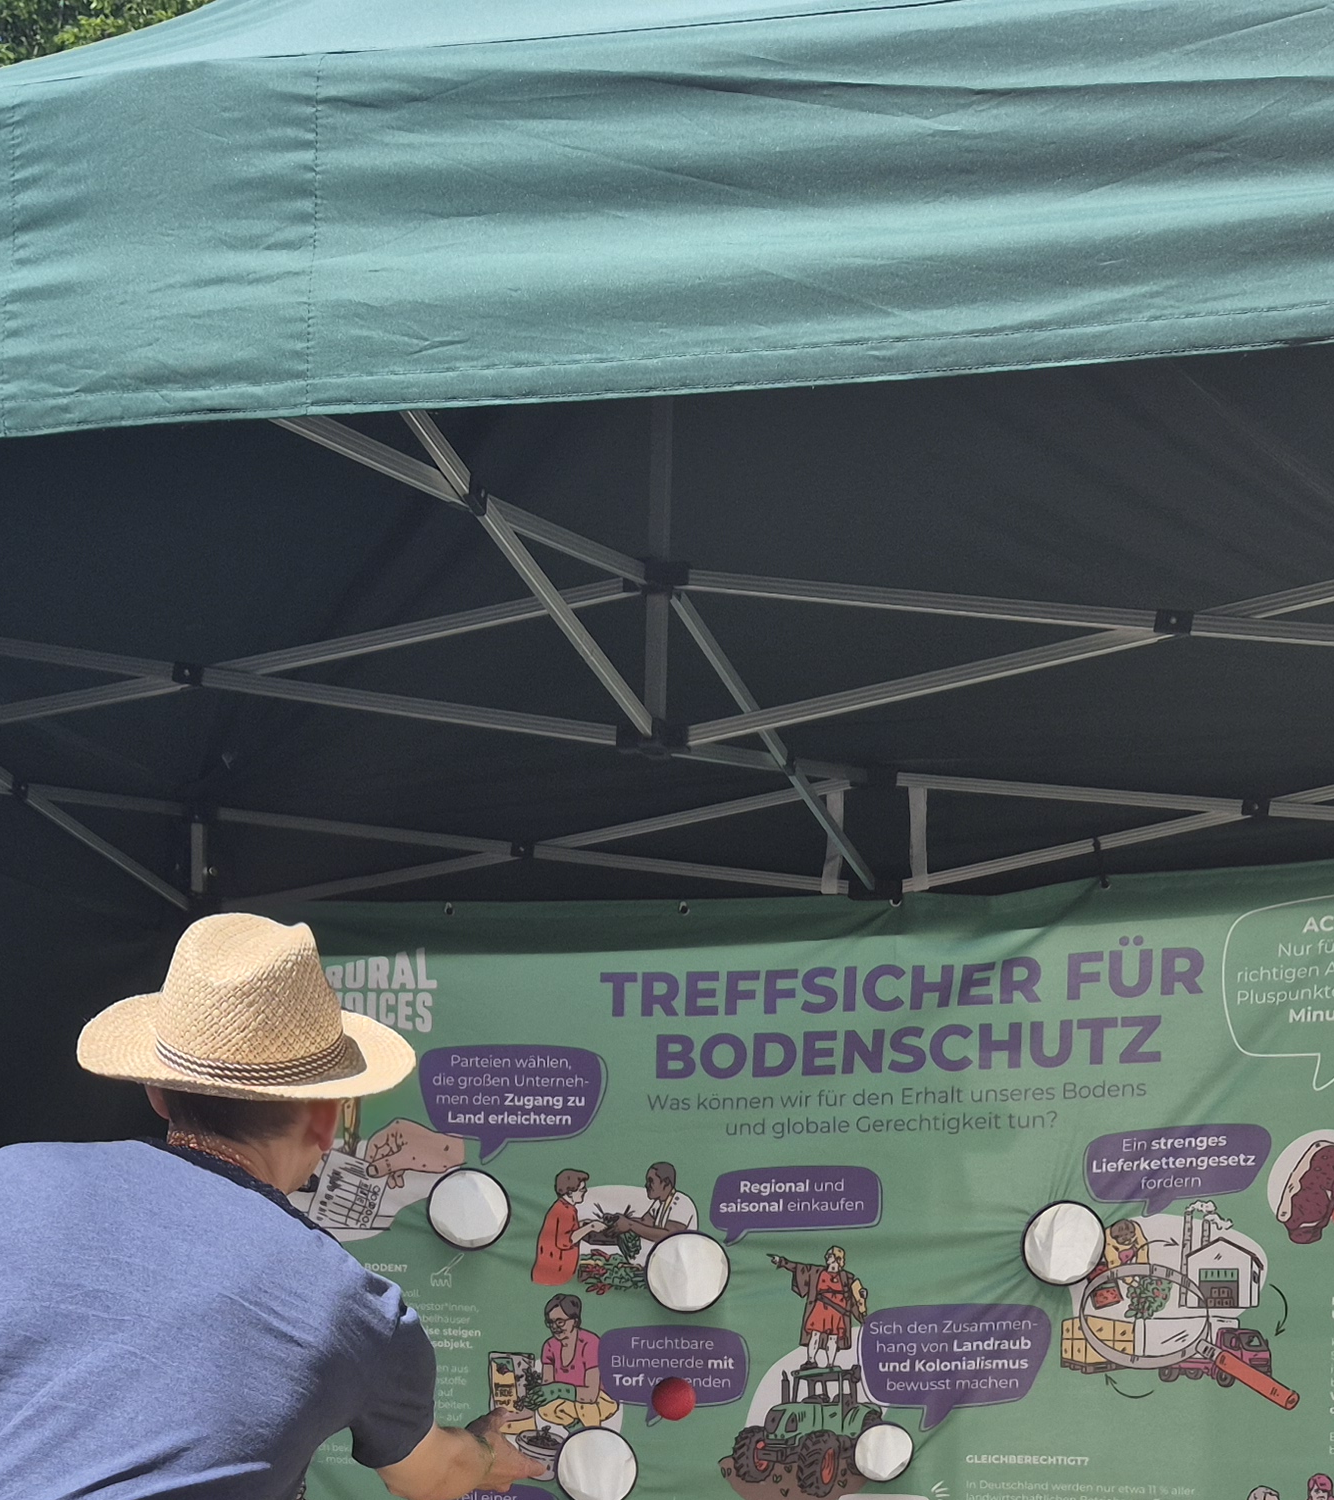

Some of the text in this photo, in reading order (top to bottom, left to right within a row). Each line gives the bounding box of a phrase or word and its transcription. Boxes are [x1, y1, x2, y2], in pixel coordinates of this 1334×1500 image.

[1277, 942, 1313, 957] Nur
[325, 947, 438, 989] RURAL
[1065, 935, 1205, 1000] FÜR
[1236, 965, 1319, 983] richtigen
[599, 955, 1042, 1016] TREFFSICHER
[336, 991, 433, 1033] OICES
[655, 1015, 1162, 1078] BODENSCHUTZ
[450, 1054, 572, 1070] Parteien wählen,
[431, 1072, 589, 1089] die großen Unterneh-
[435, 1092, 585, 1109] men den Zugang zu
[646, 1080, 1147, 1111] Was können wir für den Erhalt unseres Bodens
[447, 1110, 572, 1125] Land erleichtern
[725, 1109, 1058, 1139] und globale Gerechtigkeit tun?
[1122, 1135, 1227, 1152] Ein strenges
[1092, 1154, 1256, 1173] Lieferkettengesetz
[739, 1178, 844, 1196] Regional und
[1140, 1174, 1201, 1190] fordern
[718, 1197, 864, 1213] saisonal einkaufen
[364, 1263, 408, 1273] BODEN?
[869, 1319, 1038, 1335] Sich den Zusammen-
[630, 1336, 714, 1350] Fruchtbare
[875, 1336, 1032, 1356] hang von Landraub
[611, 1354, 735, 1370] Blumenerde mit
[878, 1356, 1029, 1372] und Kolonialismus
[612, 1373, 645, 1387] Torf
[886, 1375, 1019, 1391] bewusst machen
[965, 1454, 1089, 1465] GLEICHBERECHTIGT?
